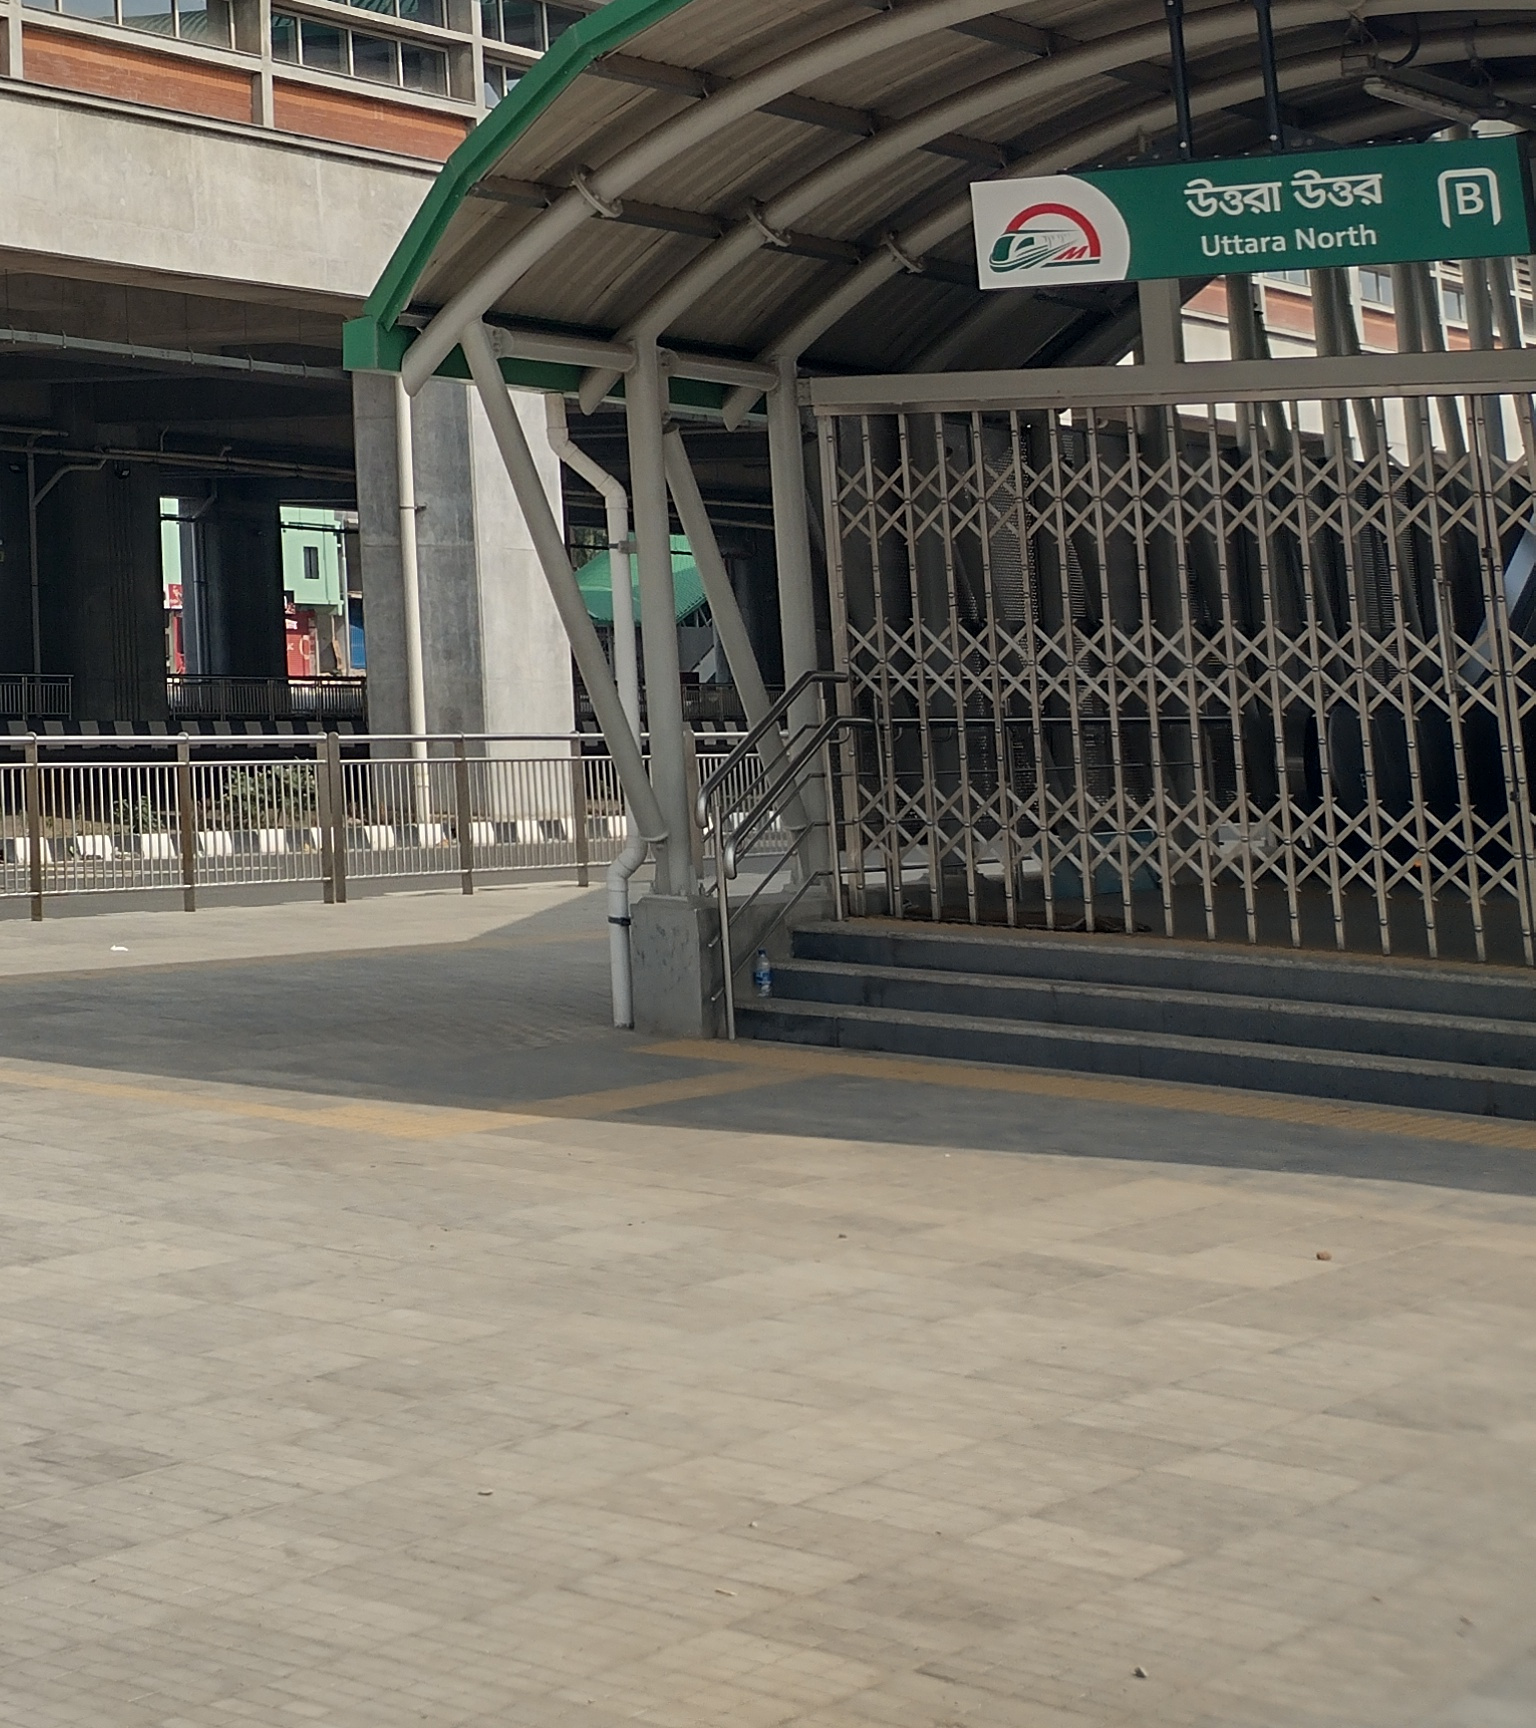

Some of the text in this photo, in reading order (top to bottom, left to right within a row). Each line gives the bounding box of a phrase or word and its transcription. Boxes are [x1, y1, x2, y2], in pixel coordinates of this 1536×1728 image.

[1184, 169, 1383, 218] উত্তরা উত্তর
[1455, 182, 1484, 216] B
[1200, 224, 1377, 257] Uttara North
